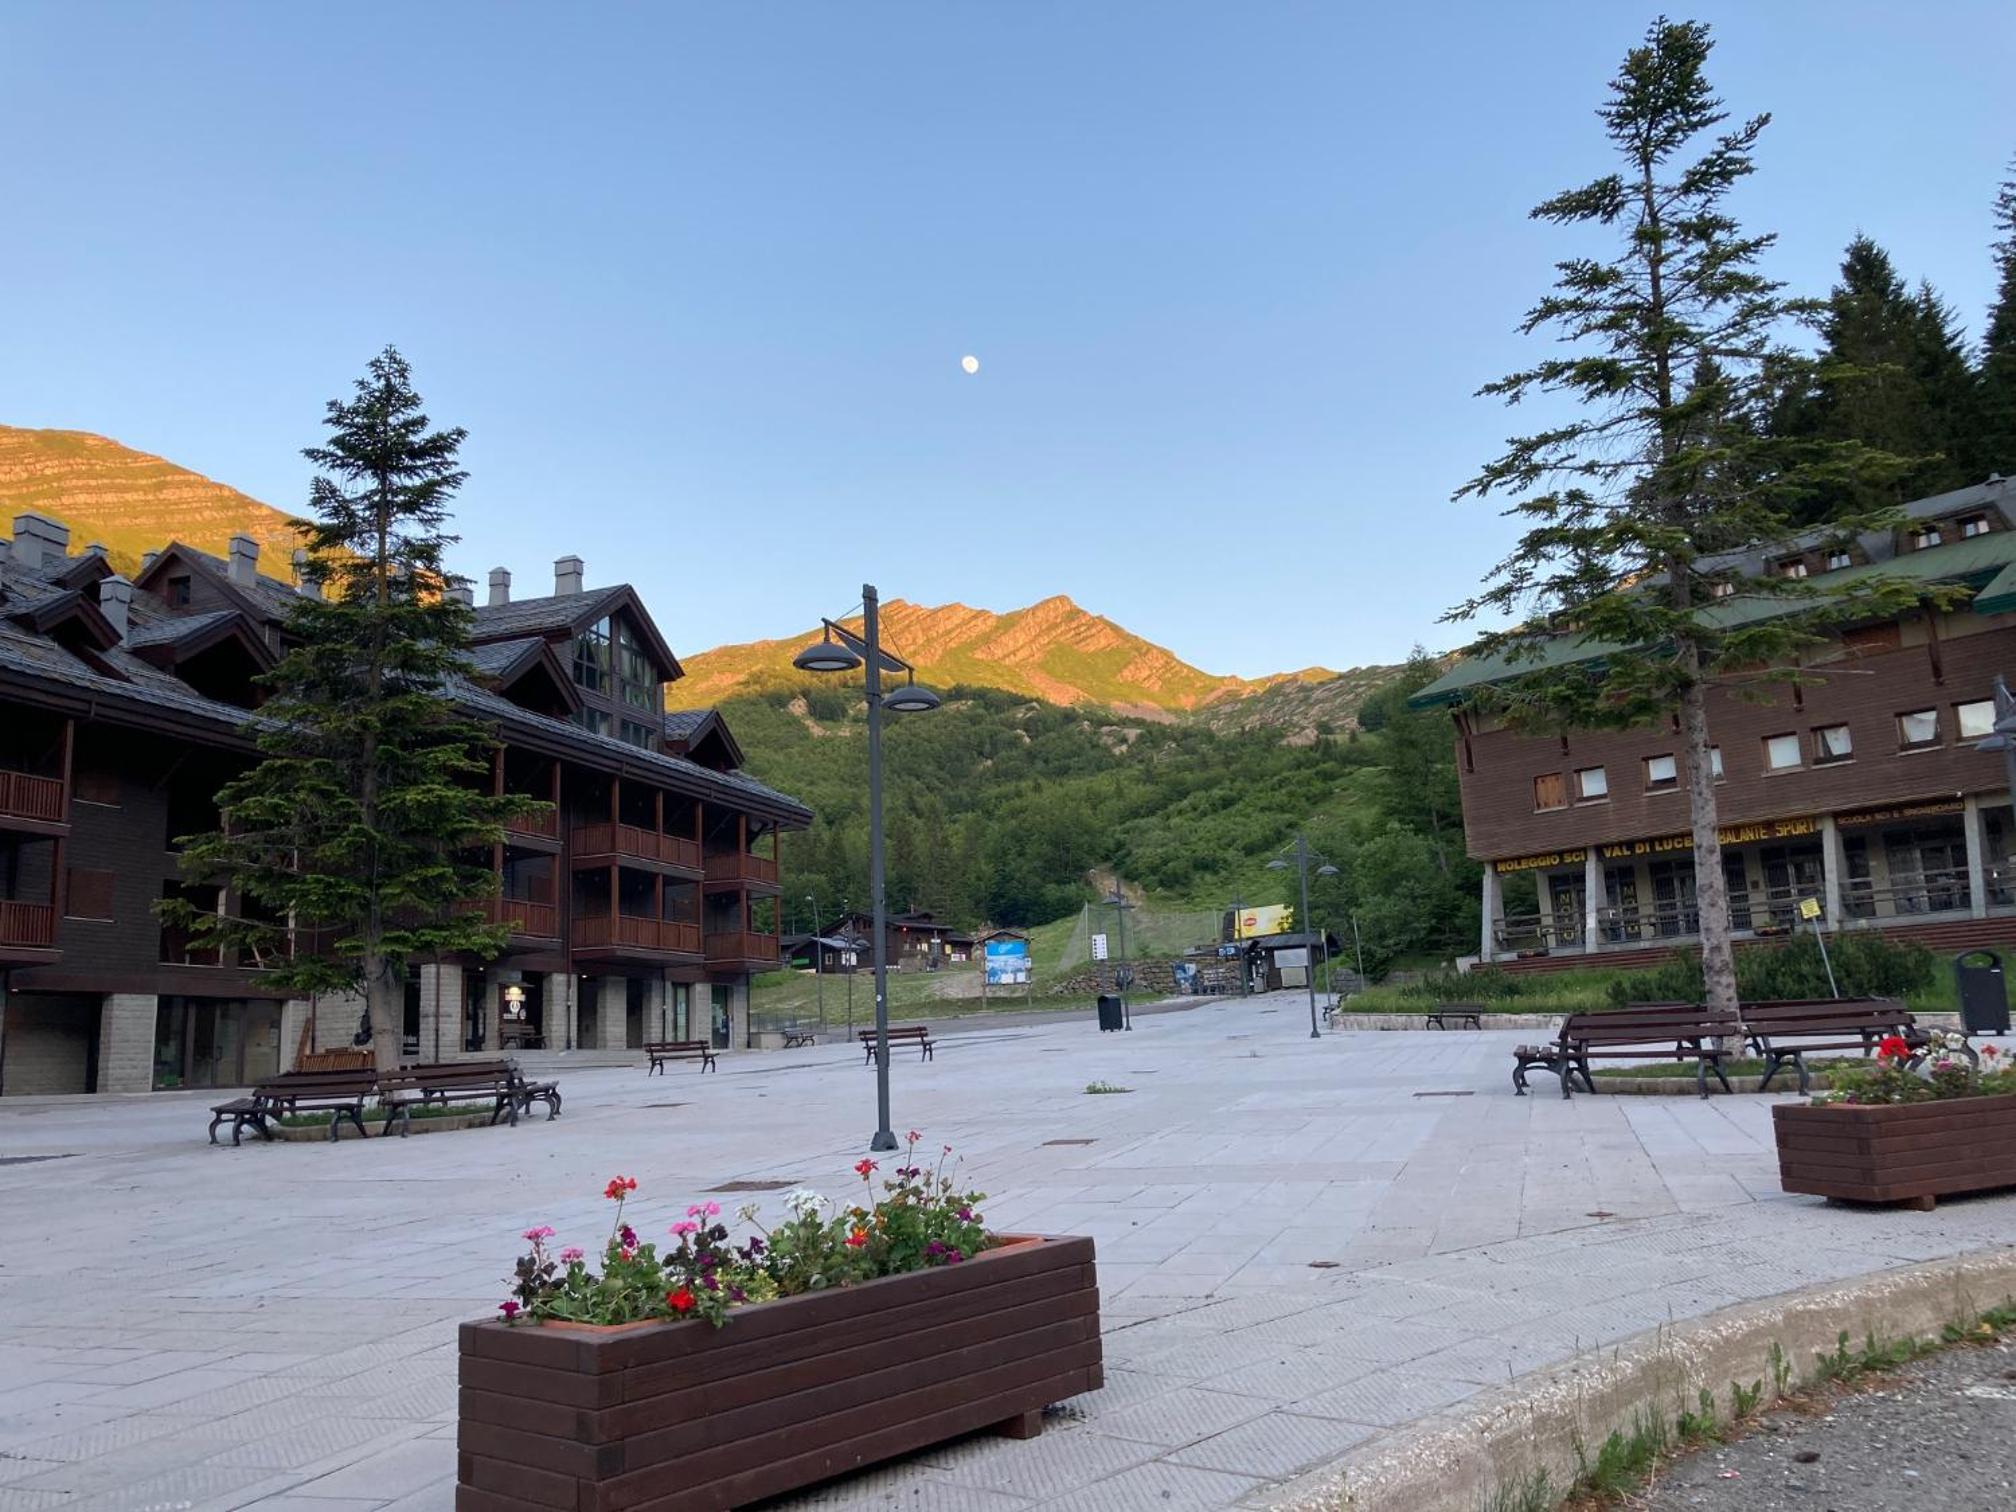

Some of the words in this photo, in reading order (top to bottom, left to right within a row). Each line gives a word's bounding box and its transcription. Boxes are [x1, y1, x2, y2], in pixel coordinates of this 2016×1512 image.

[1775, 819, 1815, 837] SPORT
[1602, 846, 1632, 858] VAL
[1634, 841, 1651, 854] DI
[1654, 836, 1695, 851] LUCE
[1497, 855, 1560, 872] NOLEGGIO
[1562, 850, 1586, 864] SCI
